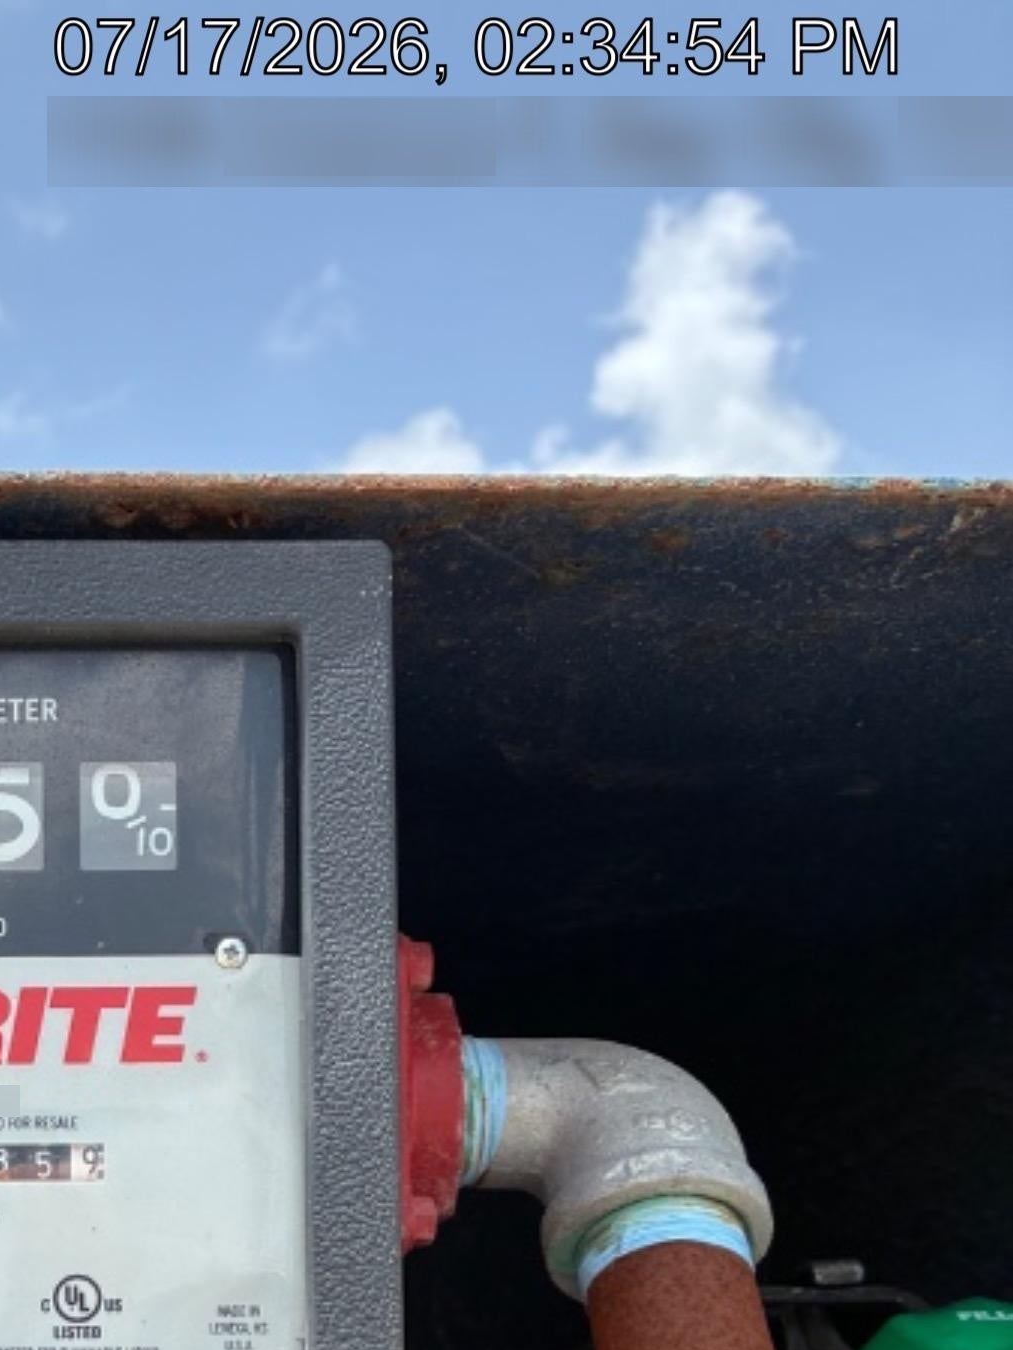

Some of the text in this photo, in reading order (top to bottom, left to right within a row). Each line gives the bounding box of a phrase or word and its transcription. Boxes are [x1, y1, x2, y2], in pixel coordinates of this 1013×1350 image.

[8, 1116, 31, 1131] FOR
[34, 1116, 78, 1131] RESALE
[104, 1298, 123, 1312] US
[53, 1325, 102, 1340] LISTED
